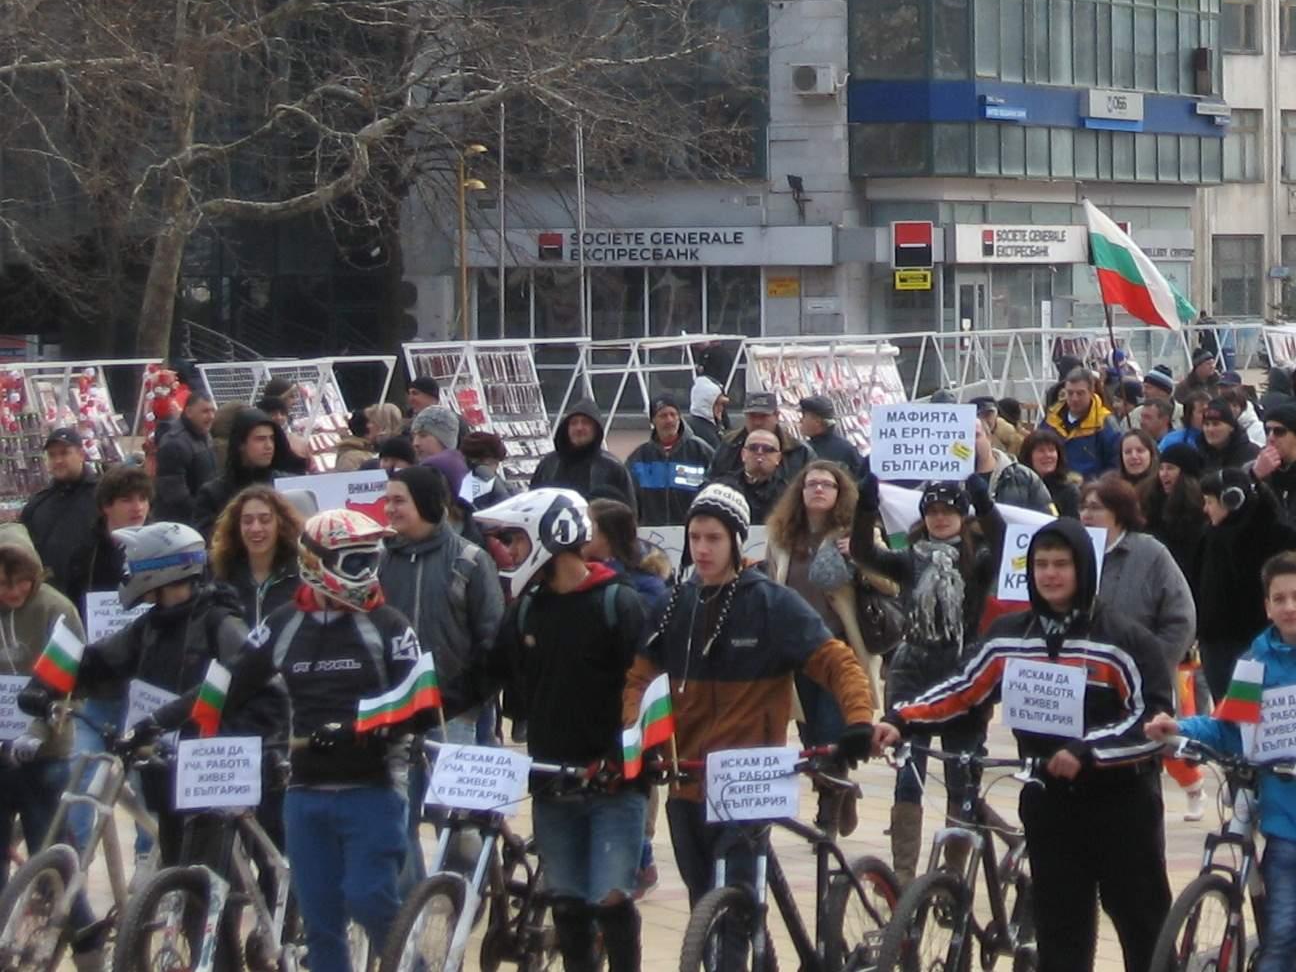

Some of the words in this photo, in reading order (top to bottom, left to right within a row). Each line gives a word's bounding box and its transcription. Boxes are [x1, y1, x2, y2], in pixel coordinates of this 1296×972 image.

[570, 232, 645, 246] SOCIETE
[650, 232, 744, 245] GENERALE
[570, 248, 700, 261] ЕКСПРЕСБАНК
[886, 411, 958, 423] МАФИЯТА
[879, 427, 898, 439] НА
[901, 427, 966, 439] ЕРП-тата
[893, 443, 924, 455] ВЪН
[928, 443, 949, 456] ОТ
[881, 460, 960, 472] БЪЛГАРИЯ
[1018, 669, 1054, 682] ИСКАМ
[1055, 674, 1070, 685] ДА
[1022, 696, 1060, 710] ЖИВЕЯ
[1009, 708, 1017, 717] В
[1018, 709, 1074, 725] БЪЛГАРИЯ
[191, 747, 226, 757] ИСКАМ
[227, 746, 244, 757] ДА
[455, 751, 494, 763] ИСКАМ
[495, 756, 512, 767] ДА
[720, 757, 760, 768] ИСКАМ
[763, 756, 780, 766] ДА
[198, 772, 236, 782] ЖИВЕЯ
[456, 776, 497, 788] ЖИВЕЯ
[193, 785, 251, 797] БЪЛГАРИЯ
[447, 787, 510, 803] БЪЛГАРИЯ
[728, 783, 771, 795] ЖИВЕЯ
